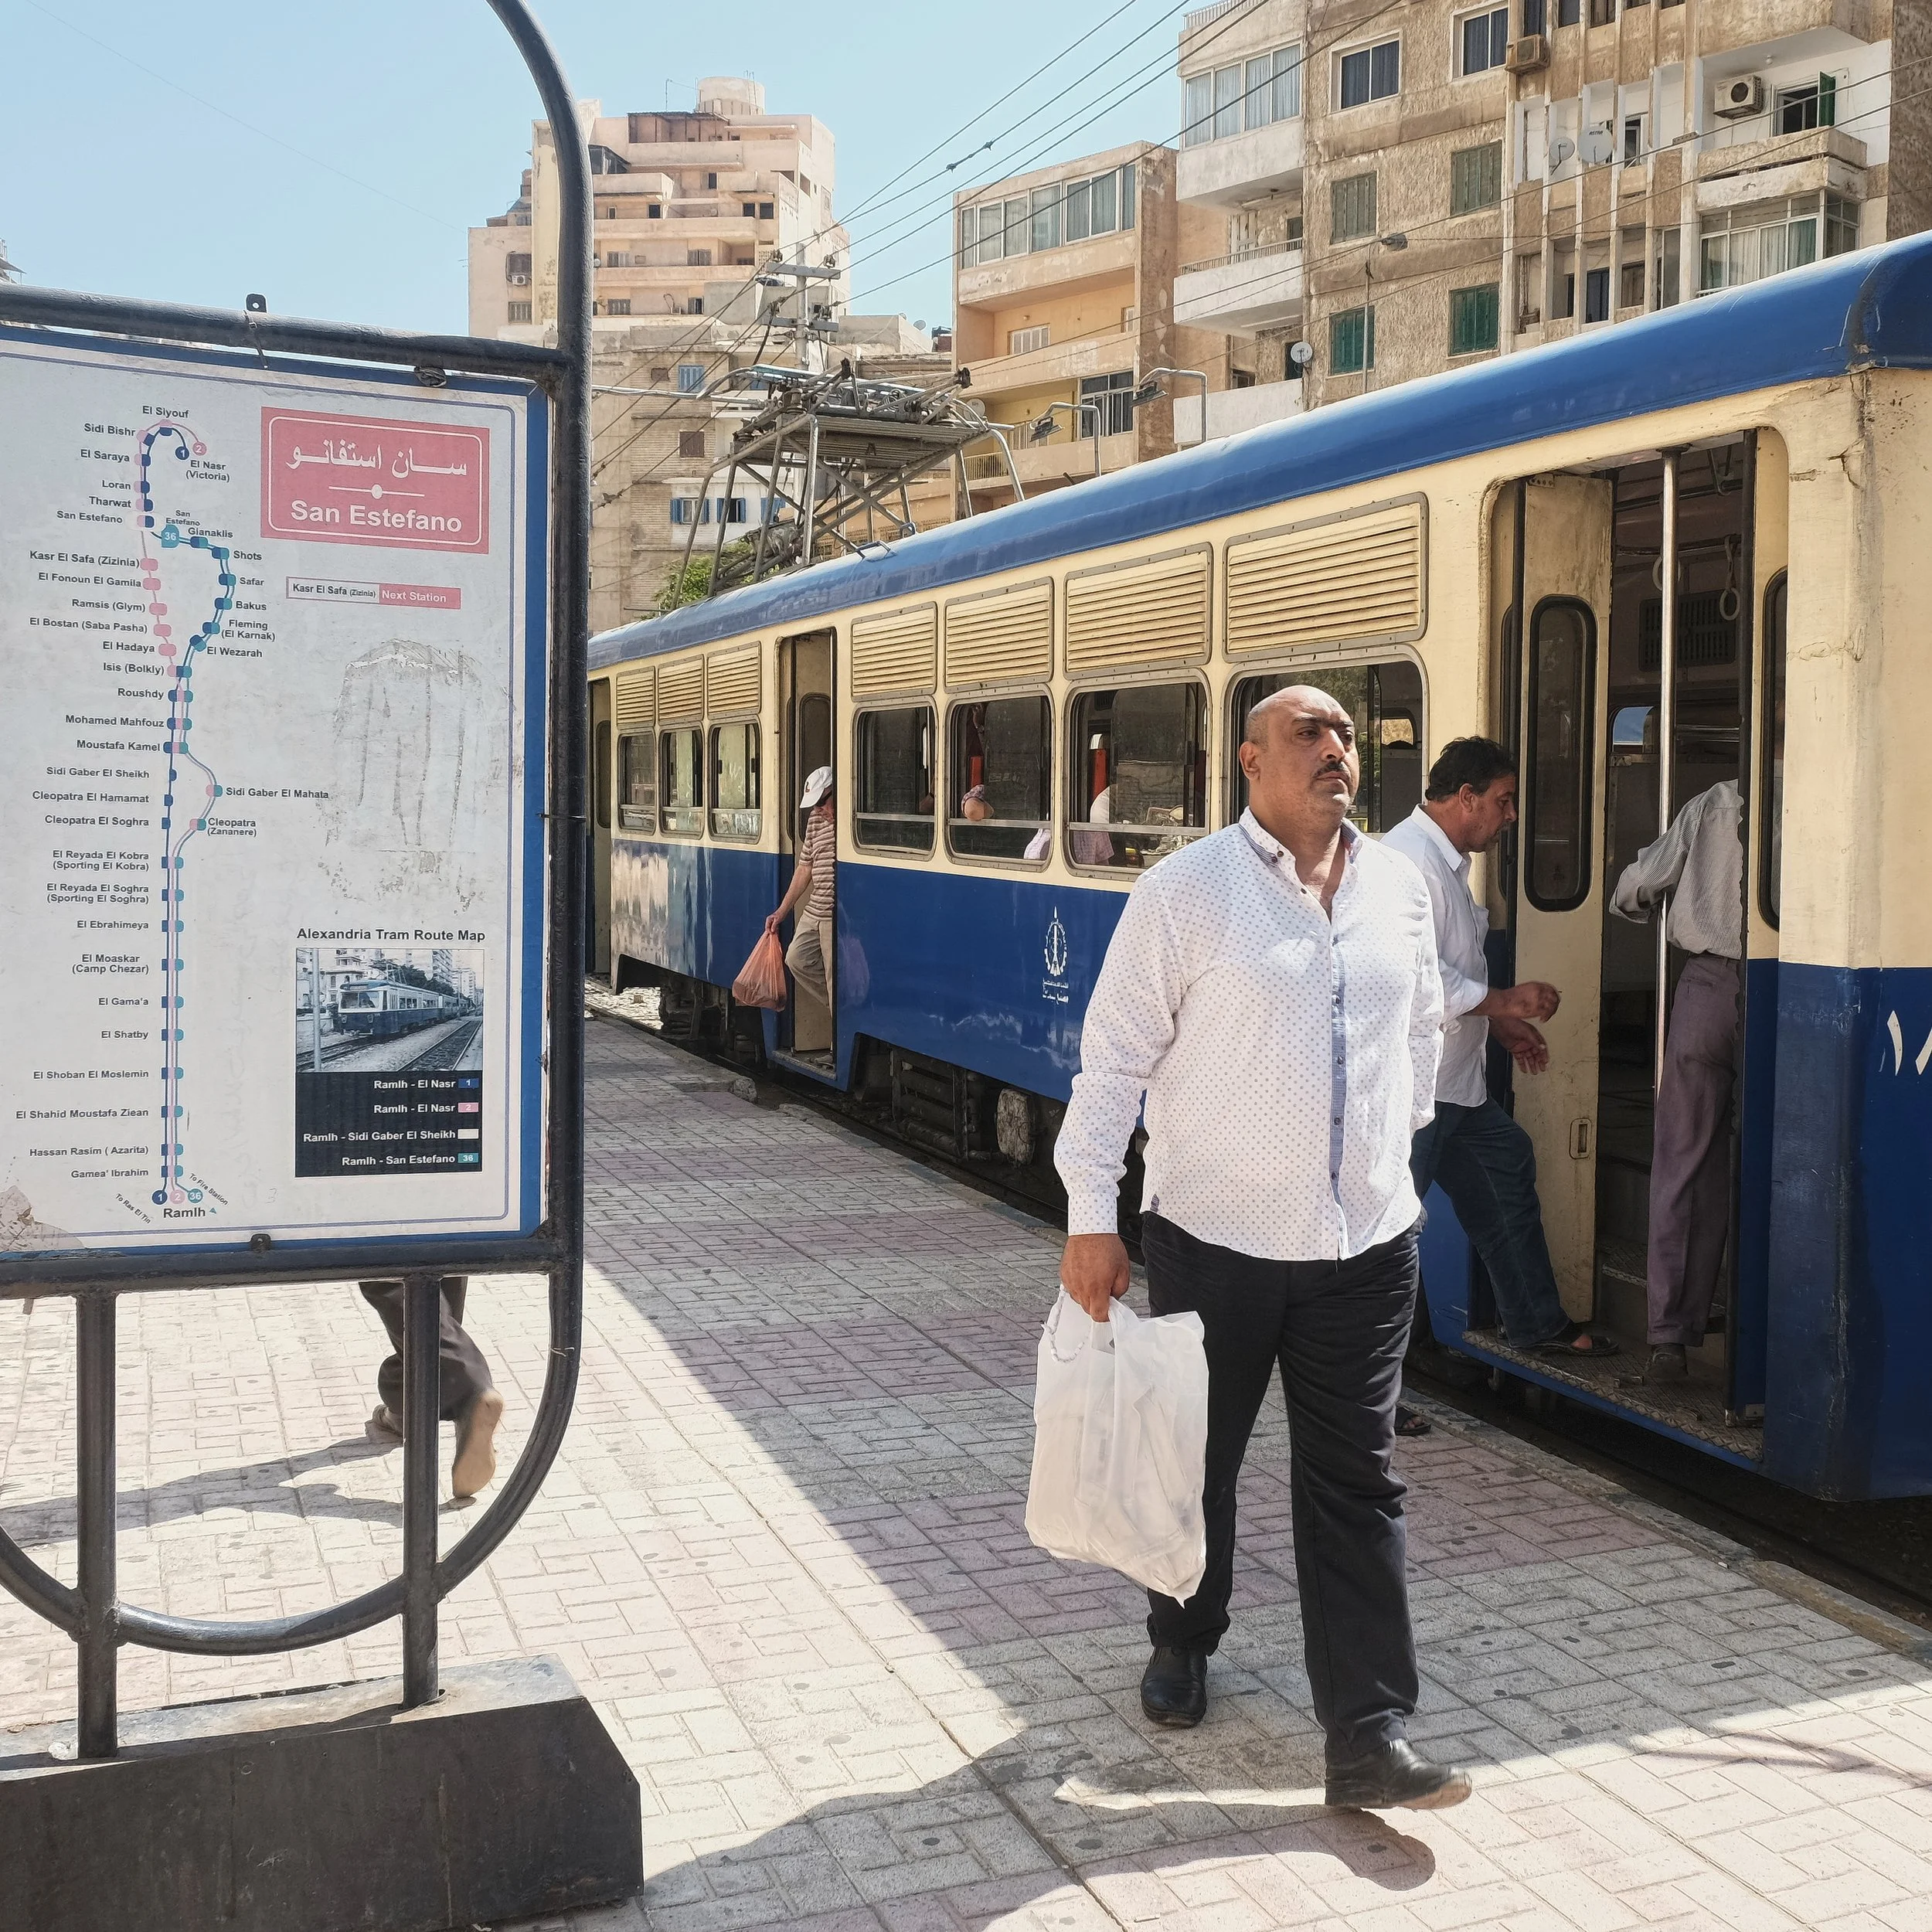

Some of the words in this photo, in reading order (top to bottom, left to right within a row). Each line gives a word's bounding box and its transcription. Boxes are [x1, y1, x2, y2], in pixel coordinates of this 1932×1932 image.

[143, 406, 152, 414] El
[84, 423, 104, 433] Sidi
[108, 426, 135, 436] Bishr
[196, 444, 202, 453] 2
[286, 439, 382, 469] استفانو
[81, 449, 90, 458] El
[94, 451, 130, 463] Saraya
[203, 461, 226, 470] Nasr
[393, 447, 467, 478] سان
[186, 470, 230, 482] (Victoria)
[102, 480, 131, 490] Loran
[89, 496, 131, 508] Tharwat
[57, 511, 76, 519] San
[80, 512, 122, 523] Estefano
[166, 518, 200, 526] Estefano
[291, 501, 339, 522] San
[351, 505, 461, 532] Estefano
[165, 532, 176, 541] 36
[30, 550, 56, 560] Kasr
[71, 554, 95, 563] Safa
[98, 556, 141, 569] (Zizinia)
[233, 550, 262, 560] Shots
[52, 573, 90, 583] Fonoun
[107, 577, 141, 587] Gamila
[240, 577, 264, 586] Safar
[294, 583, 314, 593] Kasr
[317, 585, 325, 594] El
[328, 586, 347, 595] Safa
[350, 590, 376, 598] (Zizinia)
[383, 590, 406, 600] Next
[410, 592, 446, 603] Station
[73, 599, 110, 609] Ramsis
[113, 602, 145, 613] (Glym)
[236, 601, 267, 611] Bakus
[43, 618, 79, 628] Bostan
[82, 621, 110, 631] (Saba
[114, 623, 148, 634] Pasha)
[230, 620, 267, 631] Fleming
[221, 628, 234, 639] (El
[238, 631, 275, 642] Karnak)
[104, 641, 113, 650] El
[117, 642, 155, 654] Hadaya
[207, 645, 216, 655] El
[219, 648, 262, 658] Wezarah
[118, 688, 164, 700] Roushdy
[66, 715, 117, 725] Mohamed
[121, 717, 164, 727] Mahfouz
[77, 740, 124, 750] Moustafa
[128, 742, 160, 751] Kamel
[46, 767, 66, 775] Sidi
[116, 770, 149, 778] Sheikh
[32, 791, 83, 802] Cleopatra
[100, 794, 149, 803] Hamamat
[226, 787, 245, 796] Sidi
[248, 788, 278, 797] Gaber
[45, 815, 96, 826] Cleopatra
[112, 817, 149, 828] Soghra
[209, 818, 256, 828] Cleopatra
[66, 851, 103, 860] Reyada
[53, 861, 100, 871] (Sporting
[116, 862, 149, 872] Kobra)
[60, 884, 97, 893] Reyada
[114, 885, 148, 894] Soghra
[47, 894, 94, 904] (Sporting
[110, 893, 148, 904] Soghra)
[90, 921, 148, 930] Ebrahimeya
[297, 929, 371, 939] Alexandria
[376, 930, 409, 940] Tram
[414, 930, 454, 940] Route
[458, 930, 485, 943] Map
[96, 954, 140, 963] Moaskar
[73, 964, 106, 975] (Camp
[114, 1031, 148, 1039] Shatby
[30, 1111, 66, 1119] Shahid
[70, 1109, 117, 1117] Moustafa
[189, 1173, 197, 1182] To
[209, 1188, 229, 1206] Station
[116, 1193, 122, 1202] To
